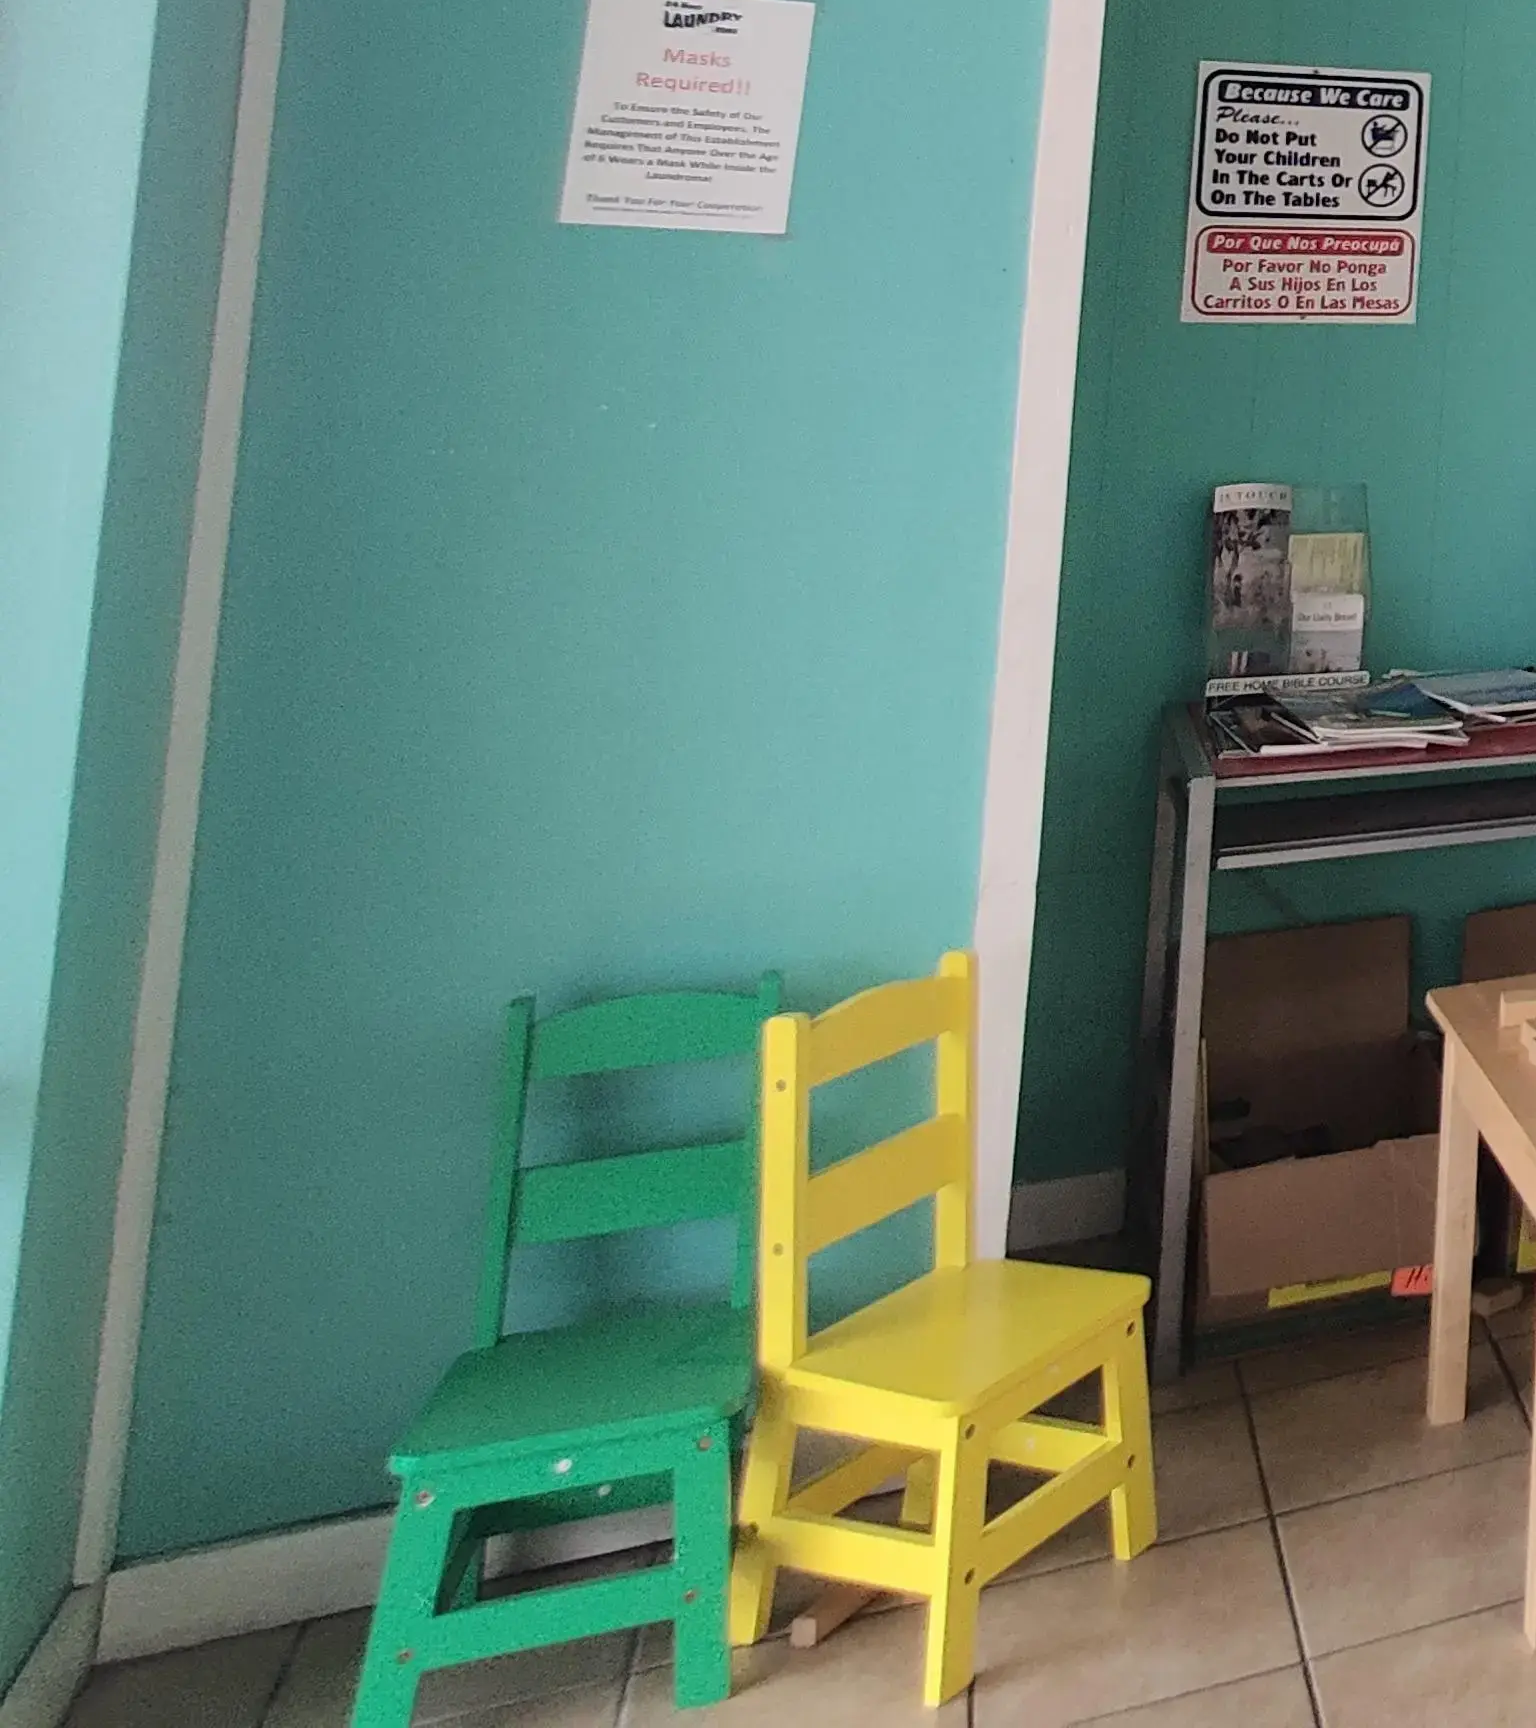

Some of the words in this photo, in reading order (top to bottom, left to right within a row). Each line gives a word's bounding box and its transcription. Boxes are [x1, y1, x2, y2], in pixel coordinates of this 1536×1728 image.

[664, 11, 743, 28] LAUNDRY
[663, 48, 731, 67] Masks
[636, 72, 750, 95] Required!!
[1223, 83, 1312, 103] Because
[1320, 87, 1349, 105] We
[1356, 90, 1404, 108] Care
[671, 107, 690, 115] the
[693, 108, 726, 120] Safety
[1215, 106, 1300, 126] Please...
[1215, 128, 1239, 144] Do
[1246, 130, 1279, 145] Not
[1286, 131, 1317, 147] Put
[1215, 149, 1257, 164] Your
[1264, 150, 1340, 167] Children
[1212, 169, 1230, 184] In
[1237, 170, 1270, 186] The
[1276, 171, 1325, 187] Carts
[1332, 173, 1353, 187] Or
[1211, 190, 1236, 205] On
[1243, 191, 1276, 206] The
[1283, 192, 1340, 208] Tables
[1212, 237, 1244, 249] Por
[1250, 238, 1283, 251] Que
[1288, 238, 1317, 251] Nos
[1222, 259, 1251, 273] Por
[1258, 259, 1303, 274] Favor
[1309, 260, 1331, 274] No
[1337, 260, 1387, 276] Ponga
[1230, 278, 1241, 291] A
[1248, 278, 1275, 292] Sus
[1281, 278, 1321, 295] Hijos
[1327, 278, 1346, 292] En
[1352, 279, 1377, 292] Los
[1204, 295, 1271, 310] Carritos
[1278, 296, 1289, 309] O
[1296, 297, 1314, 309] En
[1321, 297, 1347, 310] Las
[1352, 297, 1400, 310] Mesas
[1209, 680, 1241, 693] FREE
[1243, 679, 1279, 692] HOME
[1283, 676, 1315, 689] BIBLE
[1318, 674, 1369, 687] COURSE
